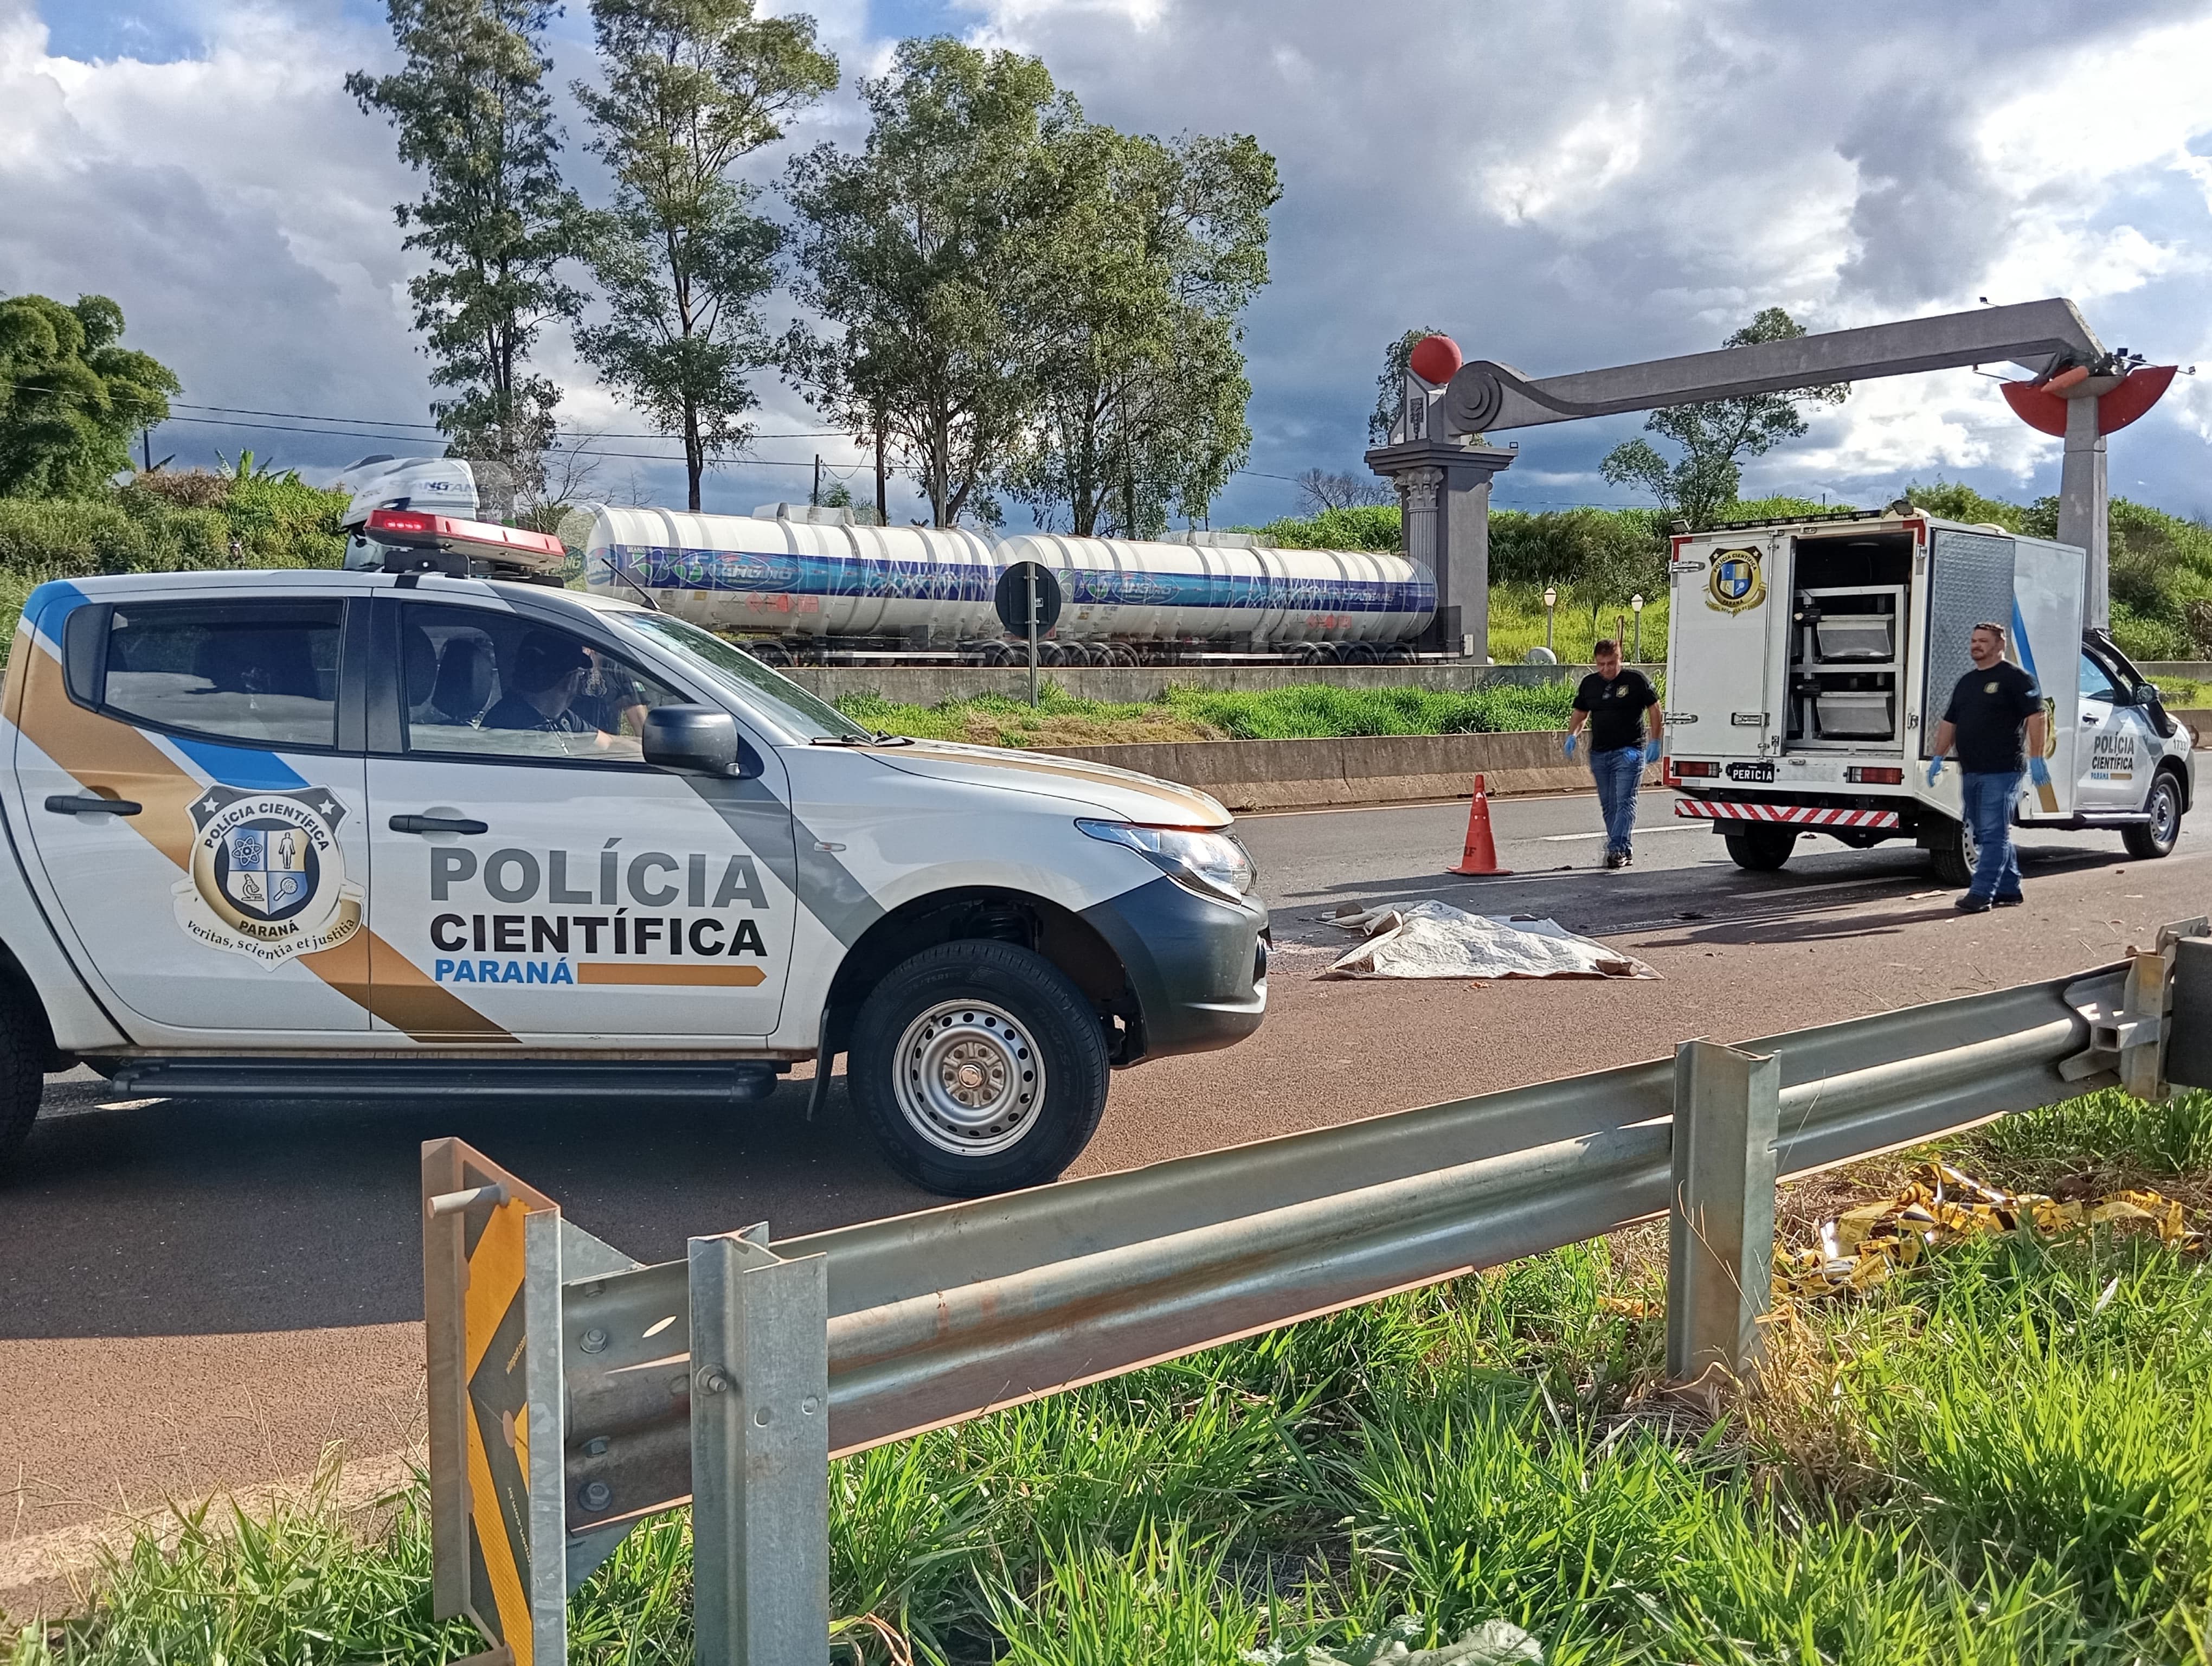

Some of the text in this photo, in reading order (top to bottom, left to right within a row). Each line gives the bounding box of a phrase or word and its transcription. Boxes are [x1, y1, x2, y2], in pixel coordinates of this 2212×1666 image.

[1714, 555, 1731, 573] POLÍCIA
[2093, 732, 2134, 755] POLÍCIA
[1733, 770, 1772, 780] PERICIA
[2092, 754, 2133, 771] CIENTÍFICA
[204, 803, 330, 851] POLÍCIA CIENTÍFICA
[430, 838, 770, 909] POLÍCIA
[187, 918, 356, 960] veritas, scientia et justitia
[239, 919, 299, 937] PARANÁ
[430, 907, 768, 956] CIENTÍFICA
[435, 957, 574, 985] PARANÁ
